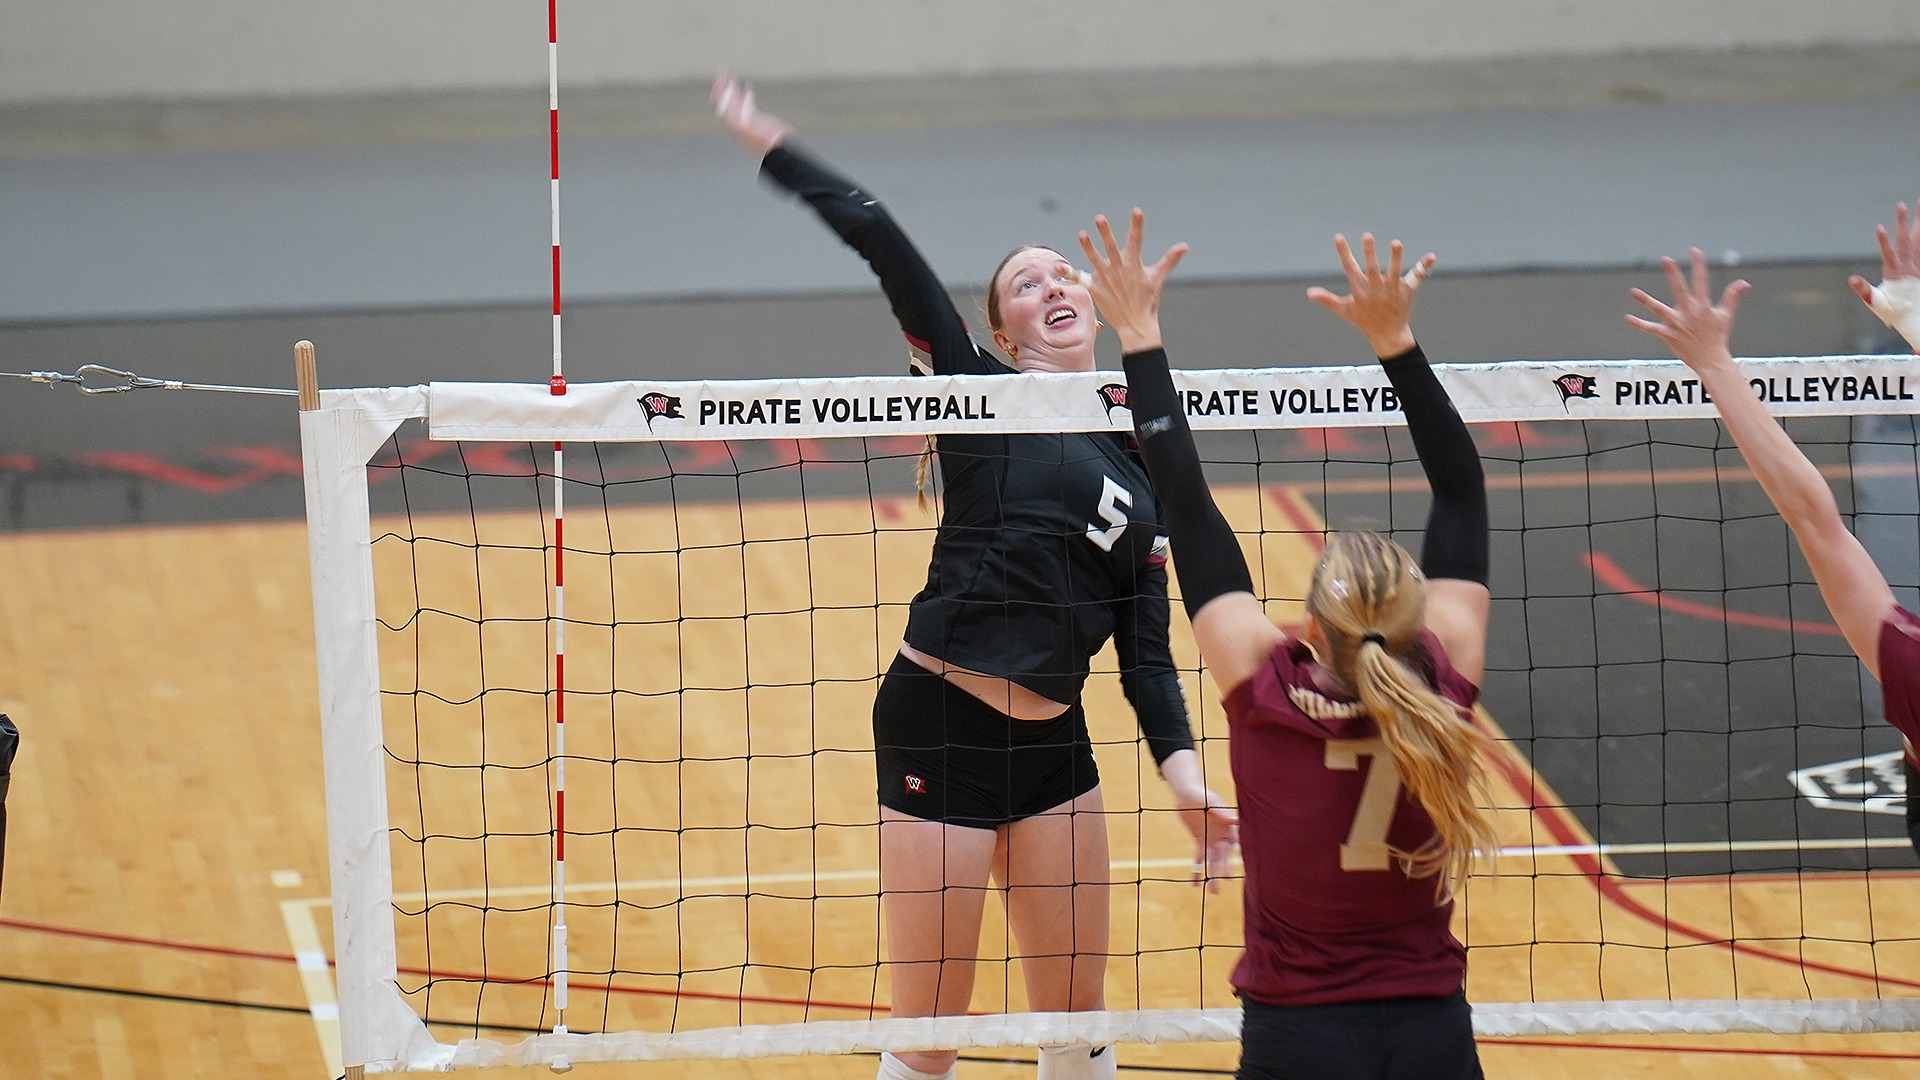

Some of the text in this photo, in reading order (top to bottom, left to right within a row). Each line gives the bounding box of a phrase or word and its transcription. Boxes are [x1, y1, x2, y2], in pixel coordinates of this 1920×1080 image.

[1103, 386, 1128, 405] W
[1561, 377, 1584, 395] W
[1748, 376, 1913, 402] OLLEYBALL
[645, 396, 668, 414] W
[699, 395, 995, 425] PIRATE VOLLEYBALL
[1178, 387, 1403, 416] IRATE VOLLEYB
[1085, 474, 1133, 553] 5
[1324, 737, 1401, 872] 7
